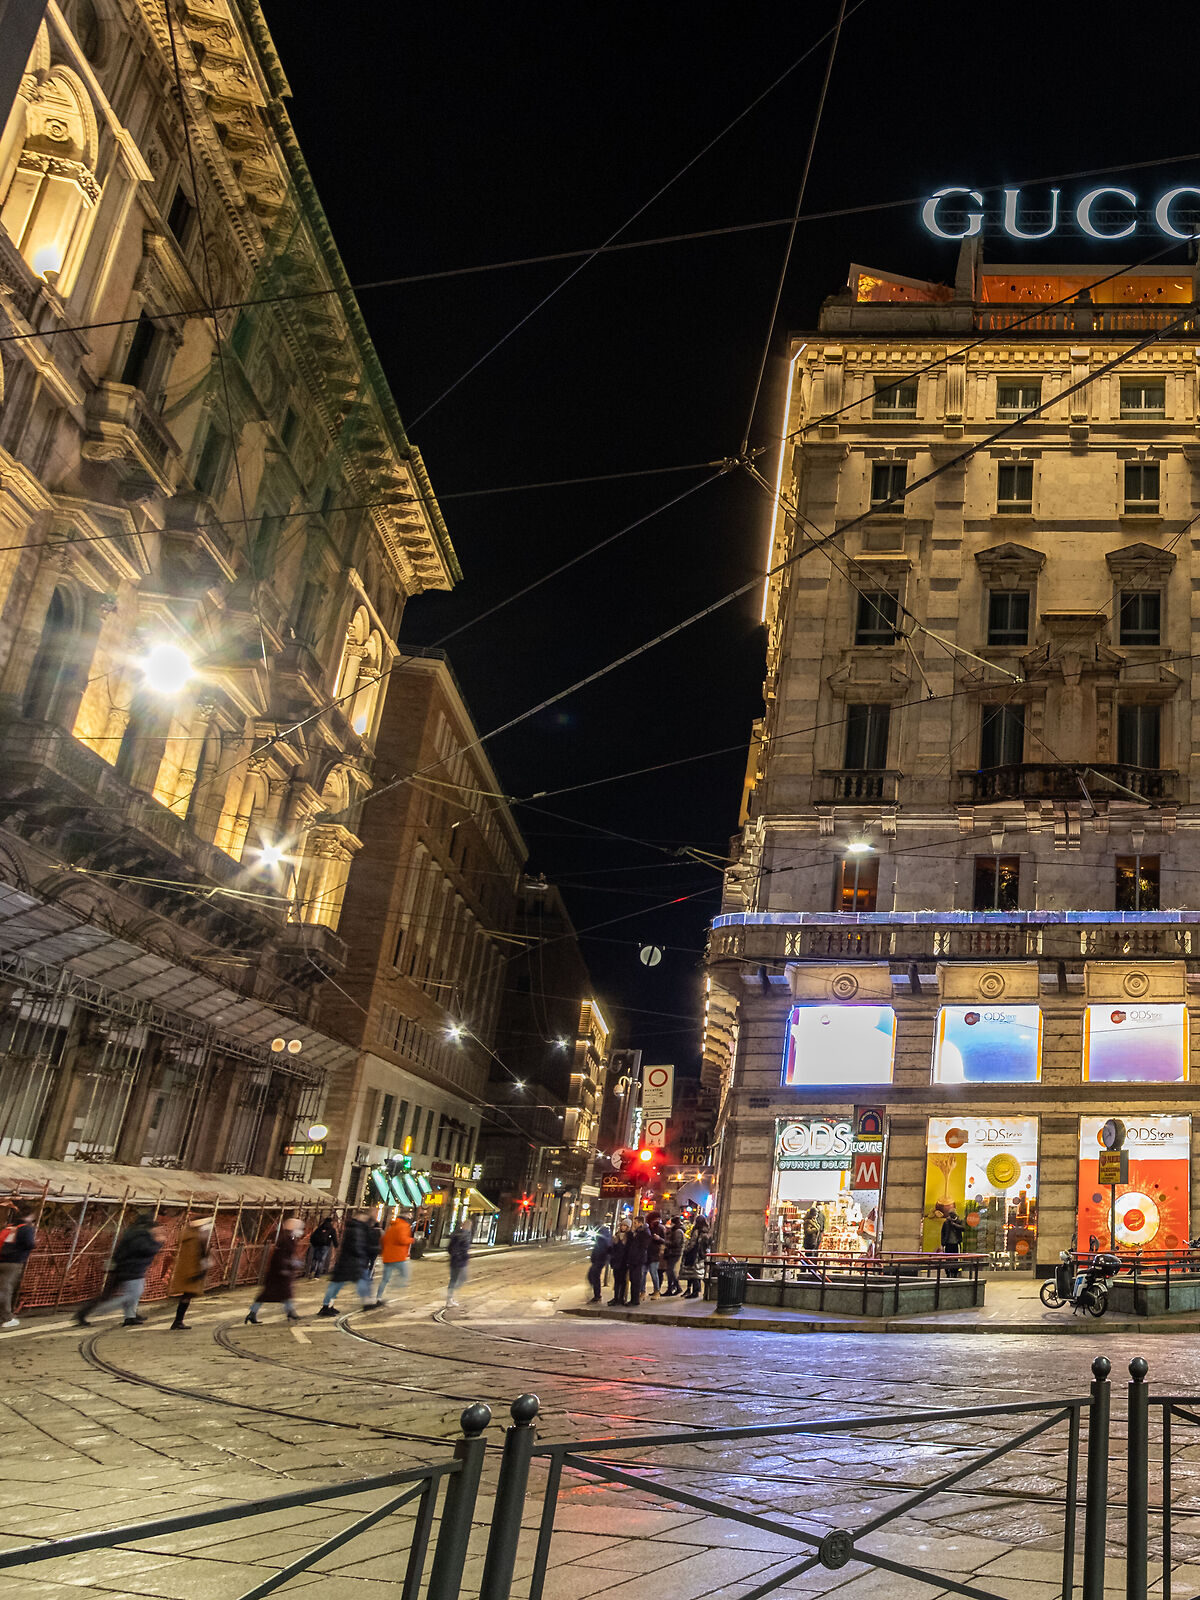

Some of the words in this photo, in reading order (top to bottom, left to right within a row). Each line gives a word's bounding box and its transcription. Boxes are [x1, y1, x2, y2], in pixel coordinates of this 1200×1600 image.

[1126, 1127, 1174, 1141] ODStore
[682, 1154, 704, 1164] RIO
[779, 1160, 821, 1170] OVUNQUE
[822, 1160, 850, 1169] DOLCE
[855, 1161, 879, 1183] M
